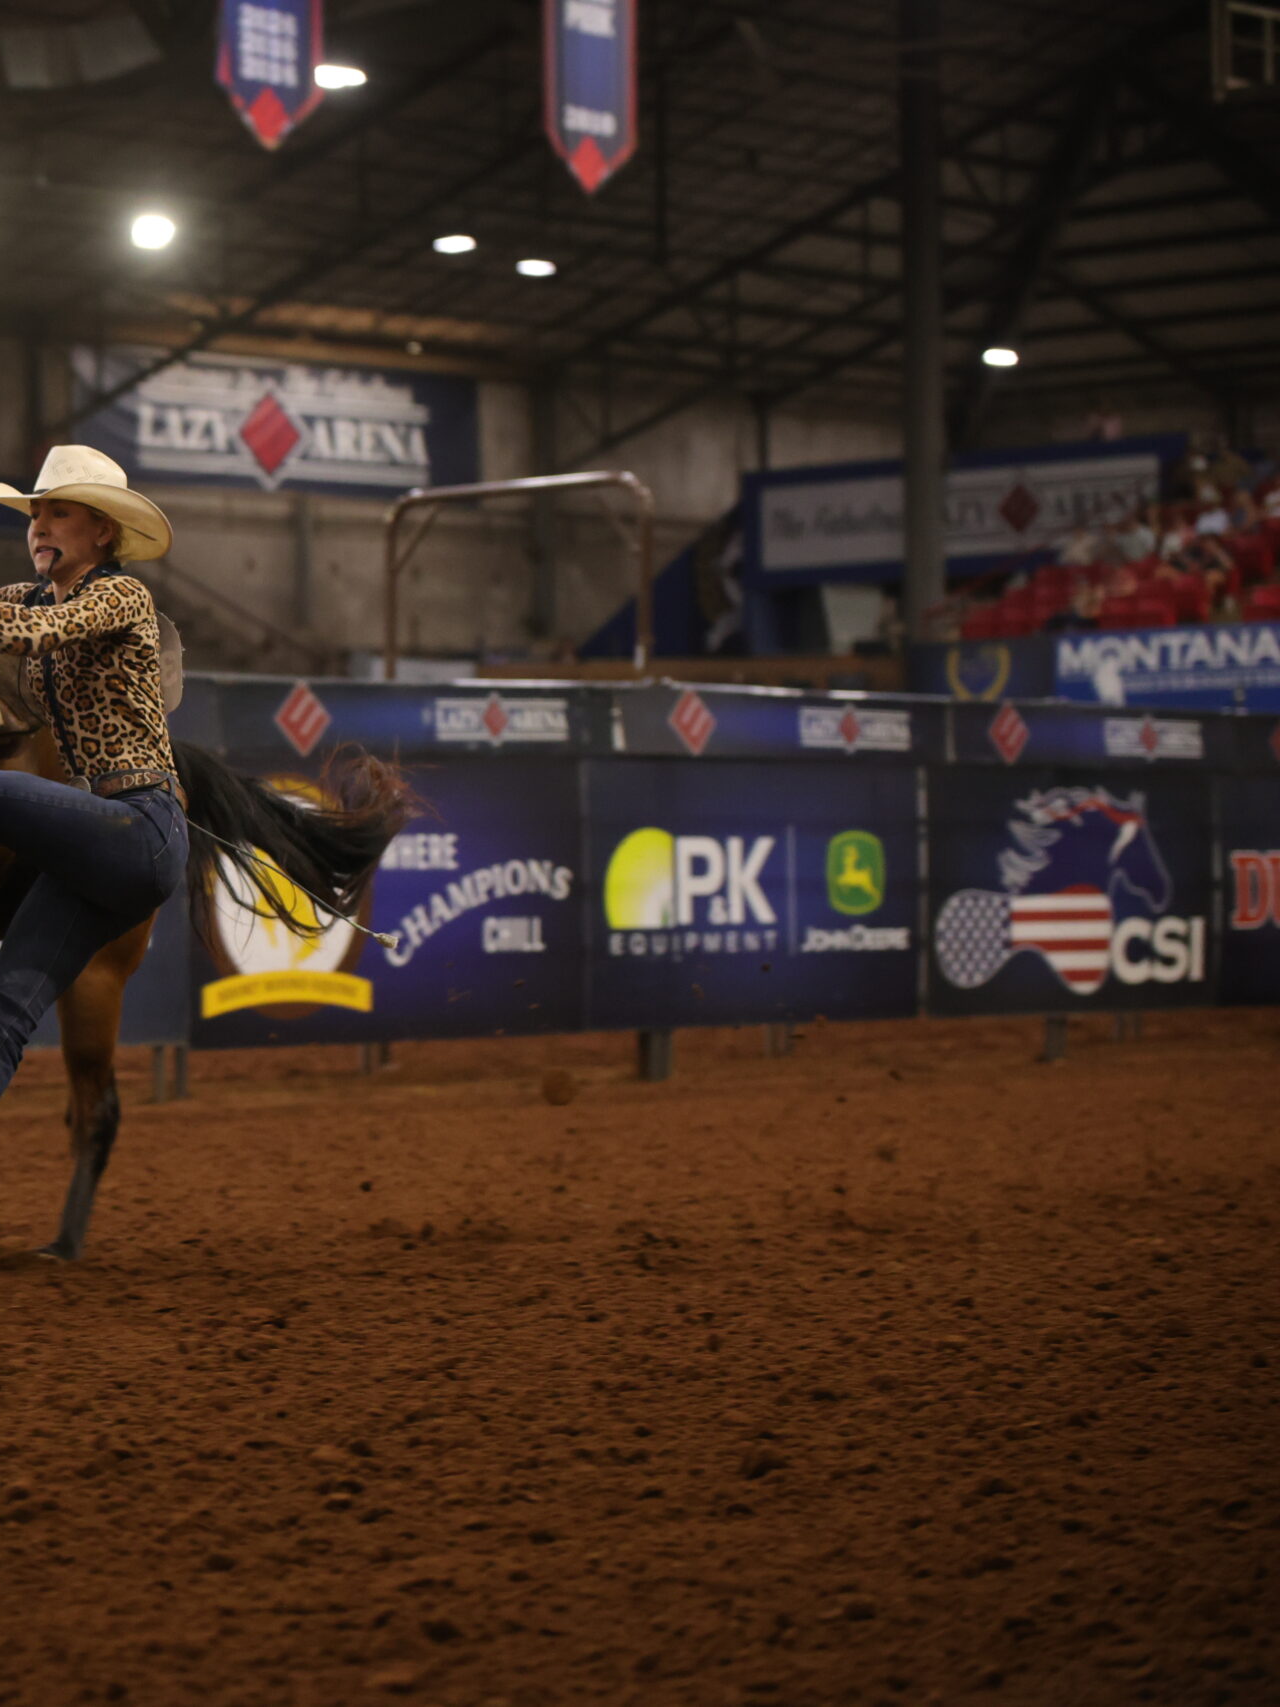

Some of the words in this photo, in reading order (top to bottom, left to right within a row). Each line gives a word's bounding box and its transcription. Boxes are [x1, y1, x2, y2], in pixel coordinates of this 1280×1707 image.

[303, 416, 430, 467] ARENA
[1057, 627, 1280, 677] MONTANA
[120, 771, 152, 790] DES
[675, 835, 778, 926] P&K
[382, 858, 575, 968] CHAMPIONS
[482, 914, 548, 955] CHILL
[608, 929, 779, 957] EQUIPMENT
[1110, 915, 1207, 986] CSI
